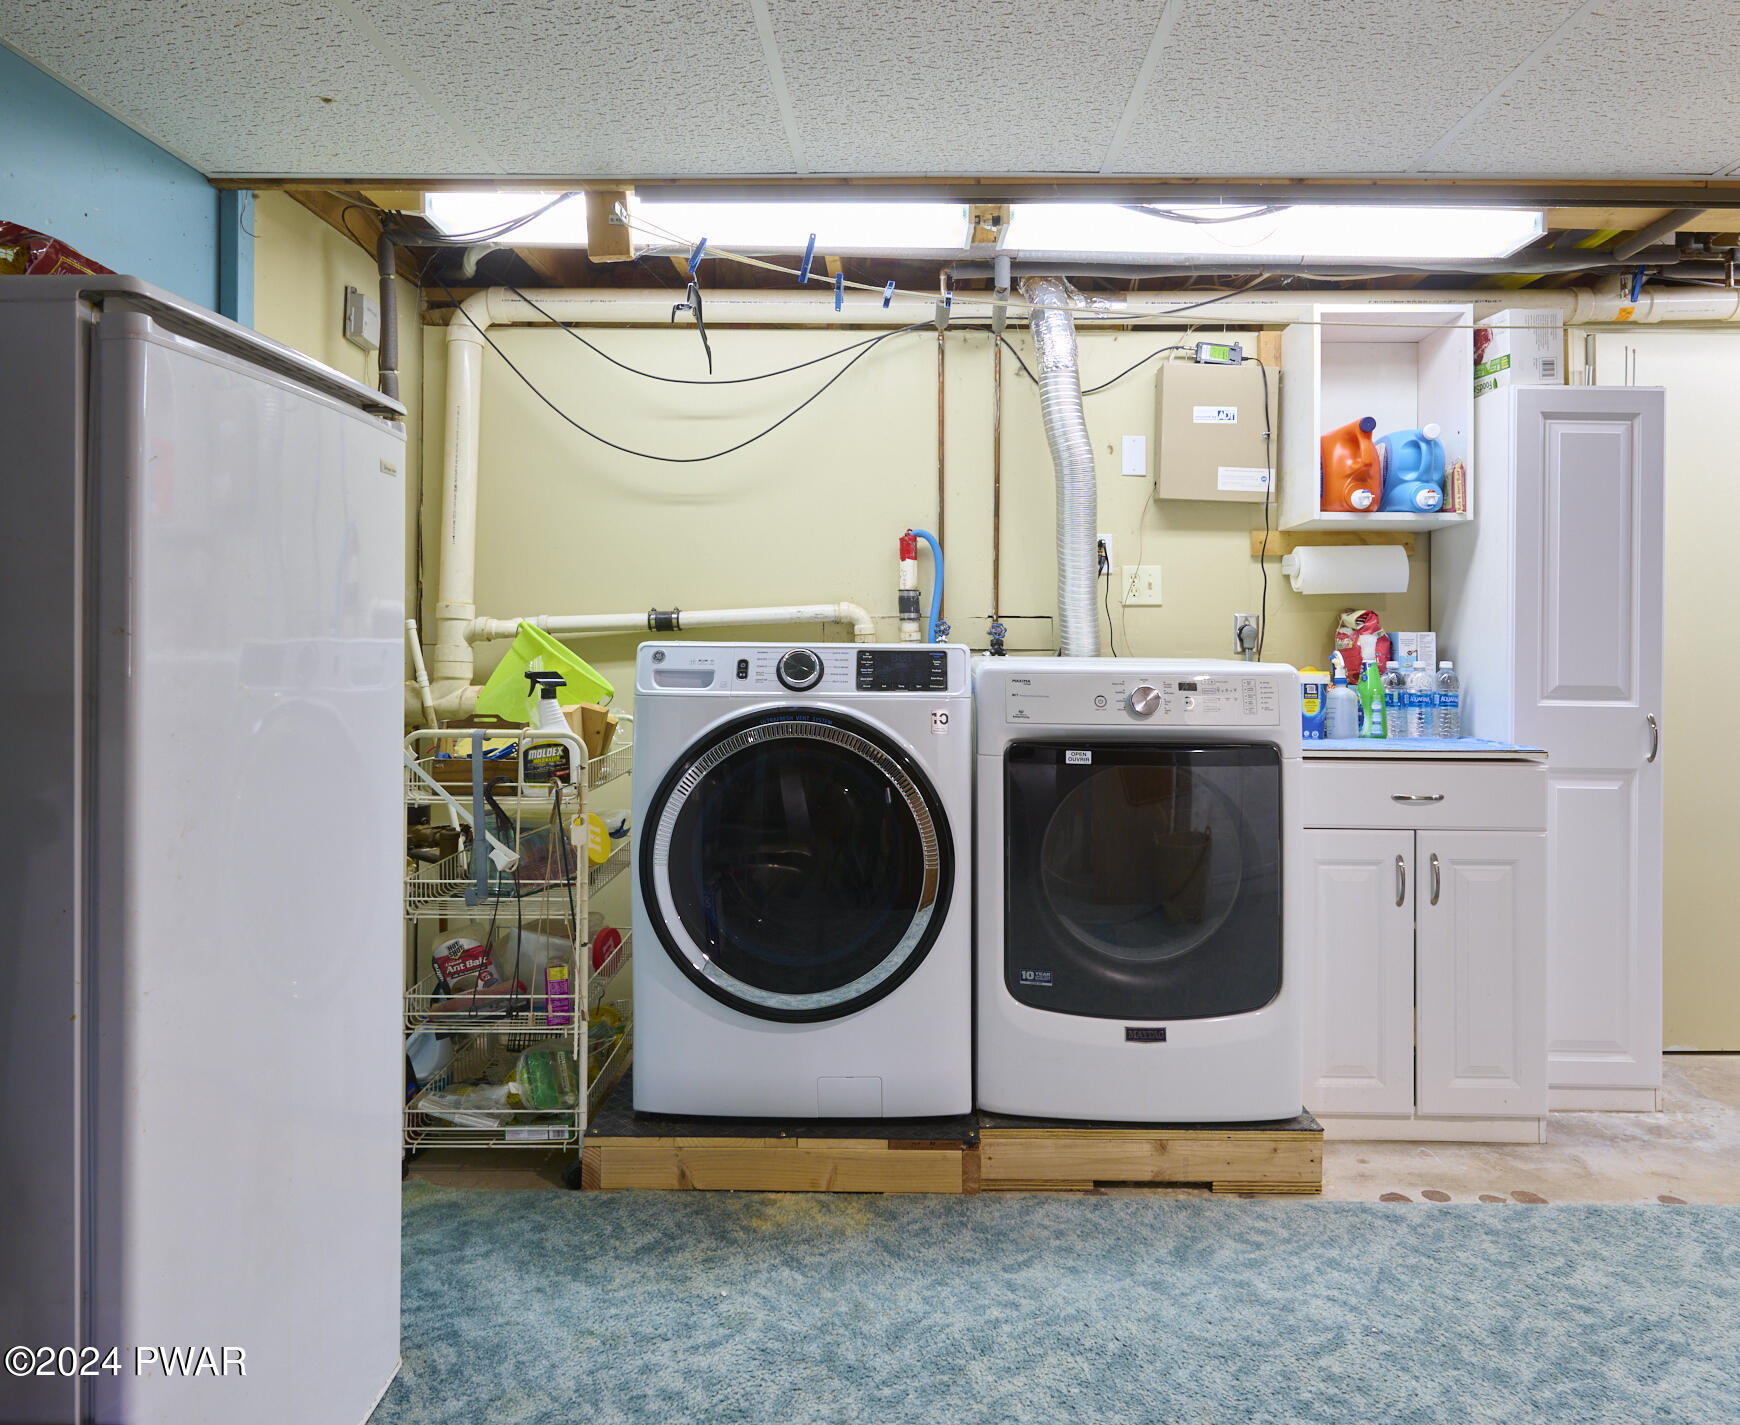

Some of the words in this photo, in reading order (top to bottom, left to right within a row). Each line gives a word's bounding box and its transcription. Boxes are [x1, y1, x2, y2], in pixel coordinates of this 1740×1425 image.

[528, 746, 563, 760] MOLDEX
[446, 963, 465, 974] Ant
[465, 956, 488, 968] Bait
[1021, 970, 1035, 980] 10
